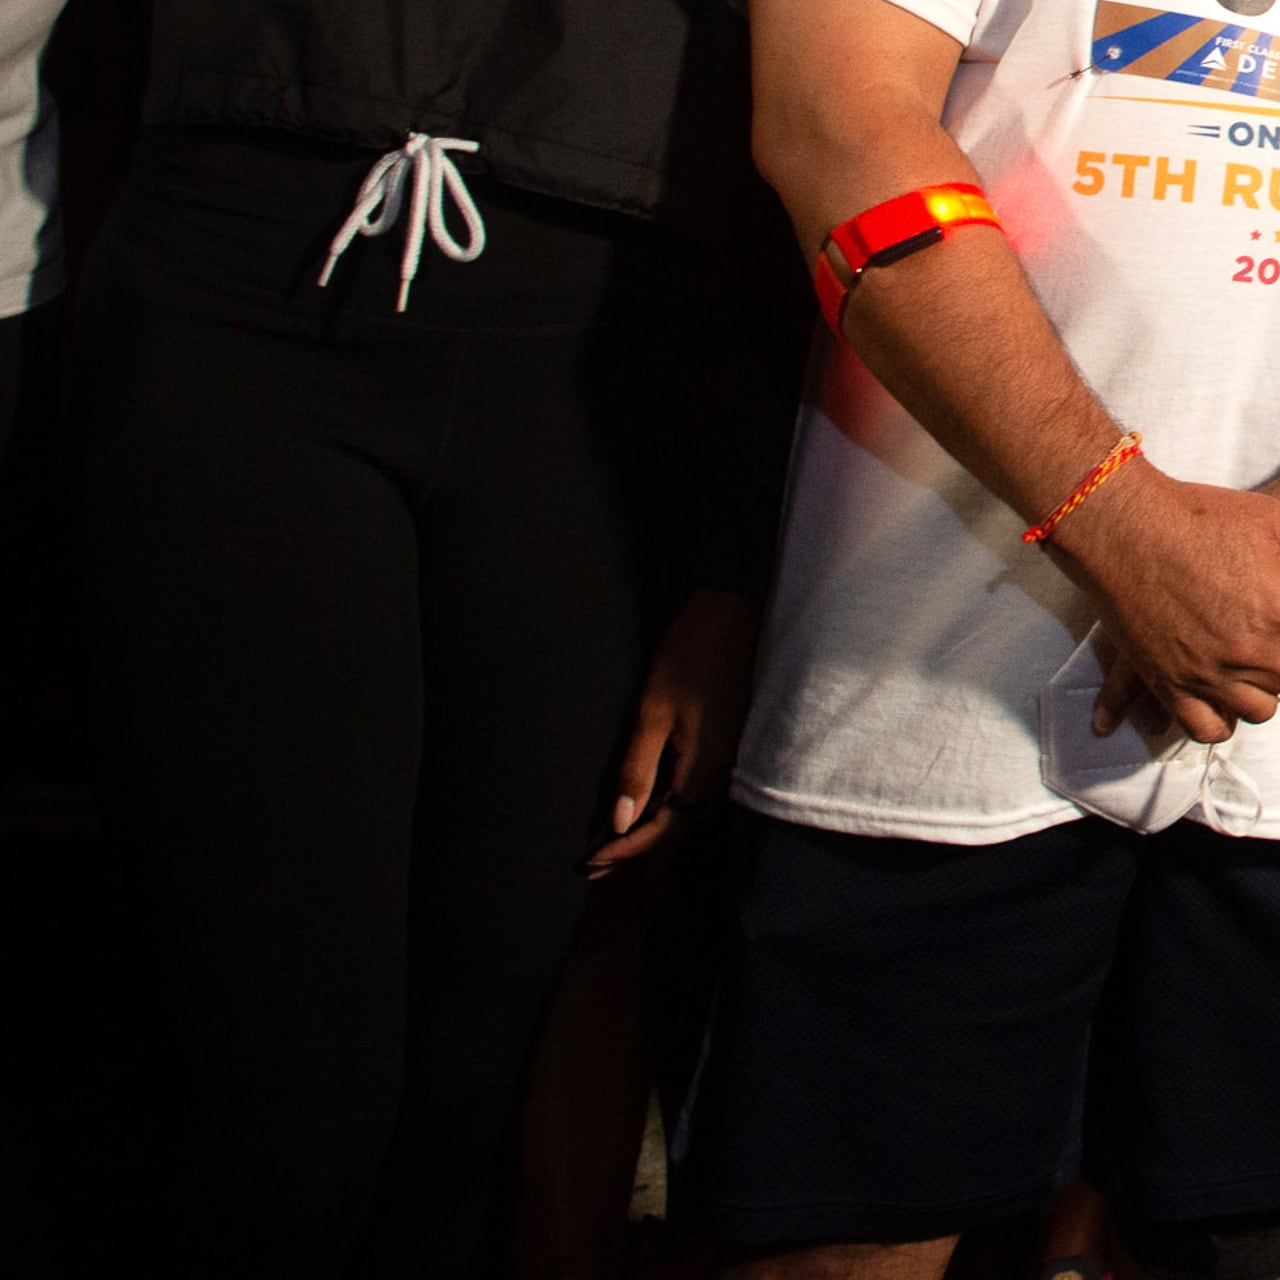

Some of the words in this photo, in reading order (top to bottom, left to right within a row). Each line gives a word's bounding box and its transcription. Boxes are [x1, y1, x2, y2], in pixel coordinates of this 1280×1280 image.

[1215, 36, 1247, 51] FIRST
[1228, 121, 1280, 150] ON
[1072, 150, 1197, 203] 5TH
